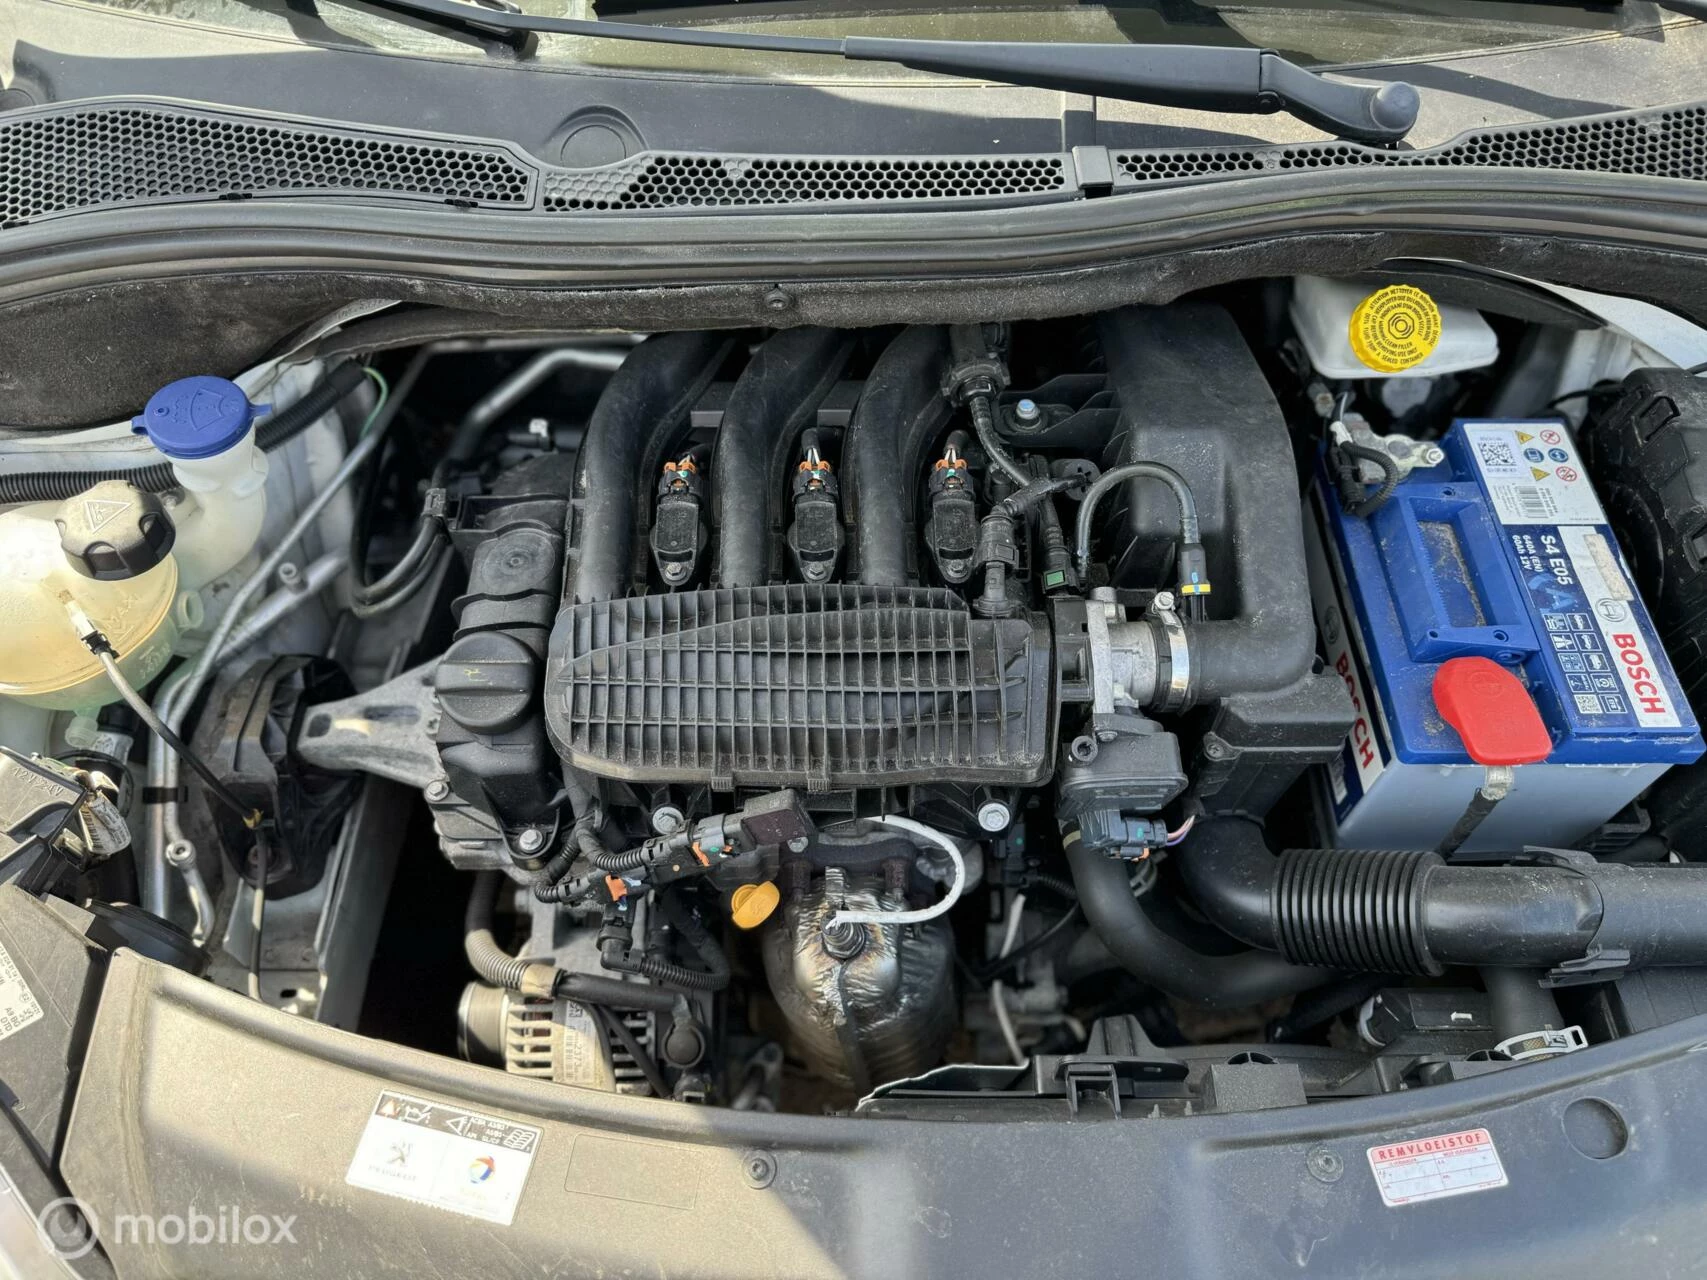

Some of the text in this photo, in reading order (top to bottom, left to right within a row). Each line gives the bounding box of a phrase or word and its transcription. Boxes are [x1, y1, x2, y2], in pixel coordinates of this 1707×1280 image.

[1540, 534, 1560, 555] S4
[1549, 558, 1574, 585] E05
[1612, 634, 1666, 713] BOSCH
[1378, 1133, 1481, 1160] REMVLOEISTOF
